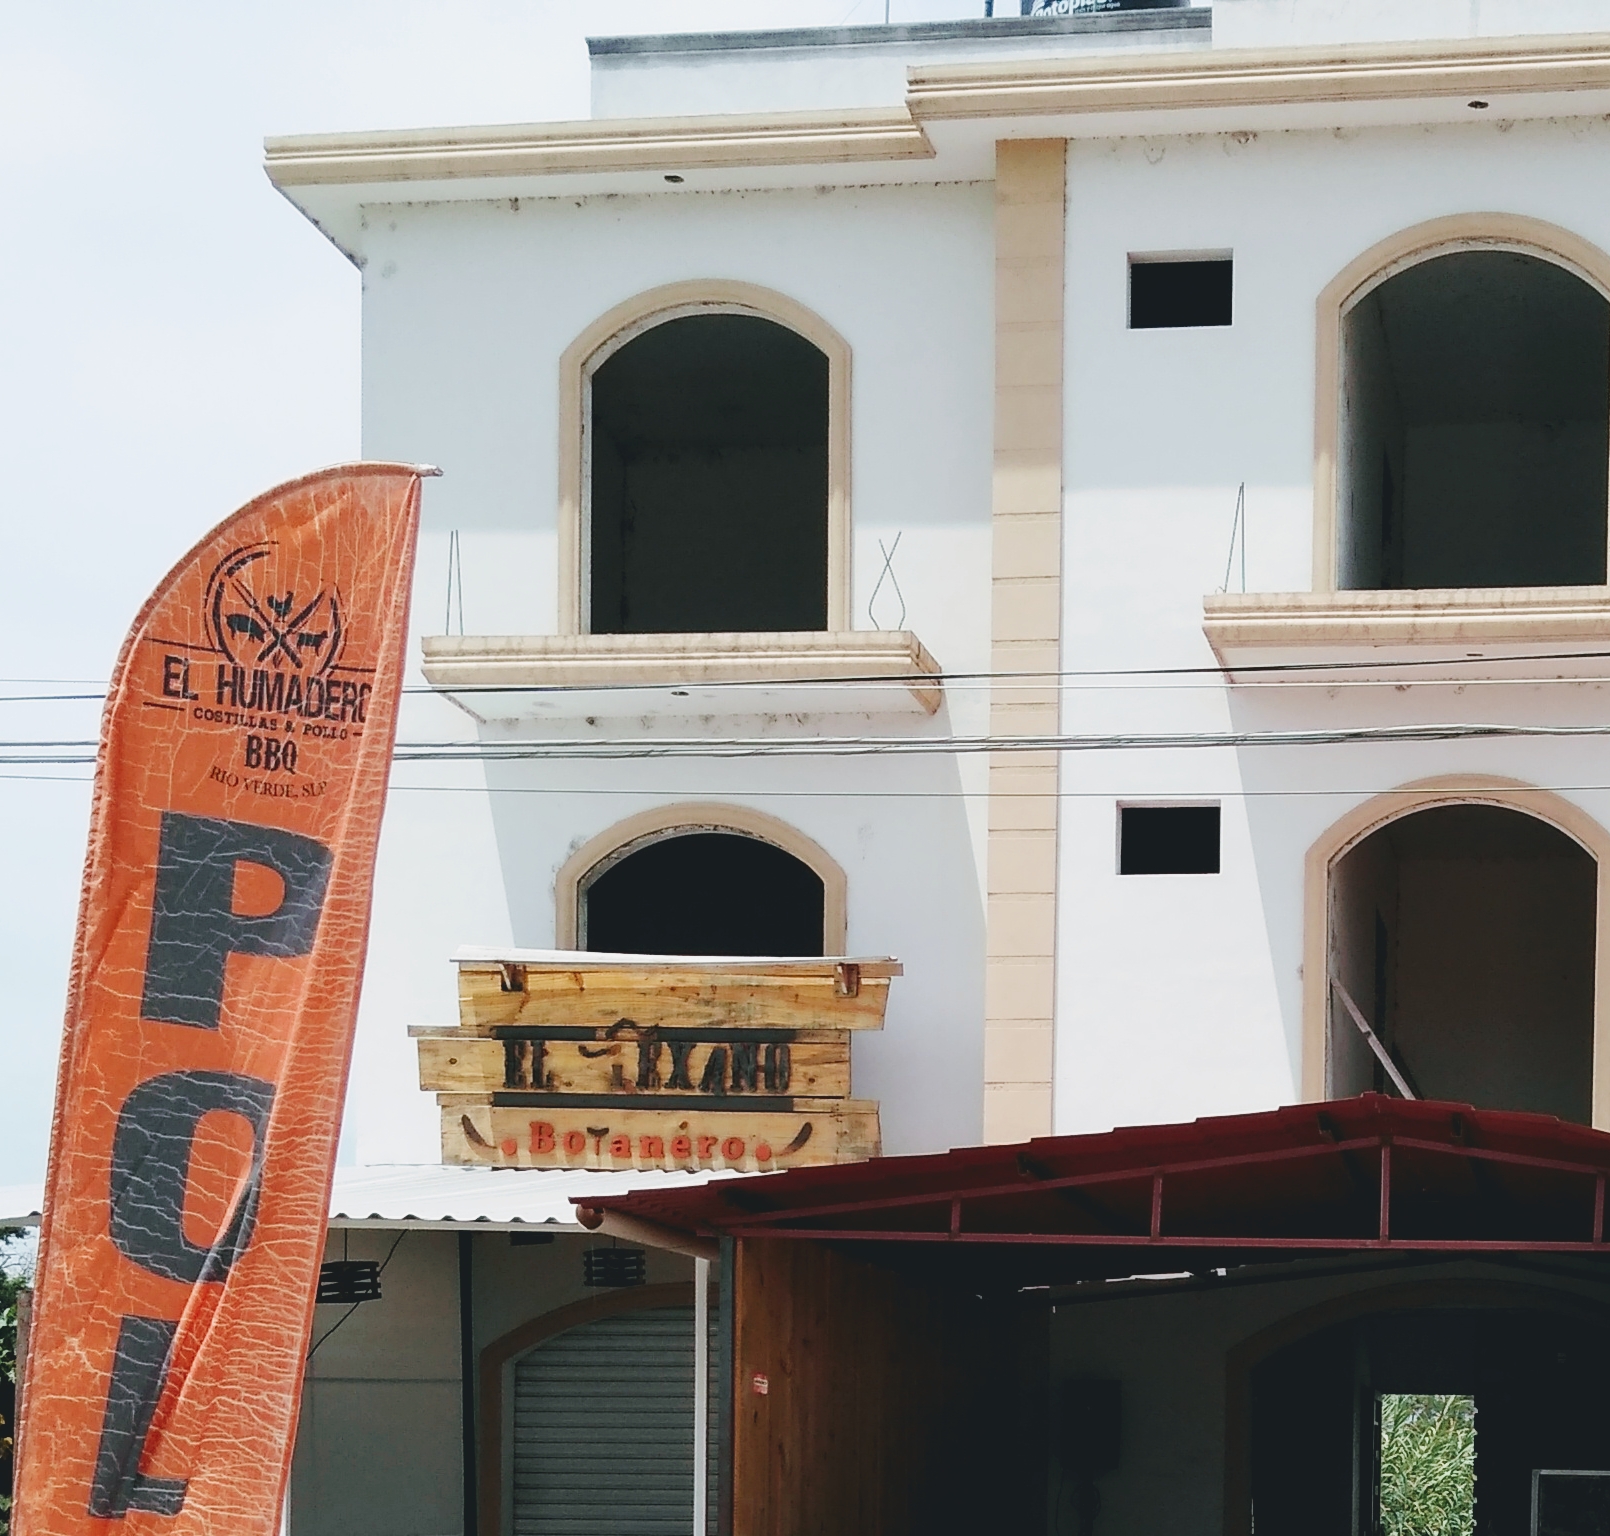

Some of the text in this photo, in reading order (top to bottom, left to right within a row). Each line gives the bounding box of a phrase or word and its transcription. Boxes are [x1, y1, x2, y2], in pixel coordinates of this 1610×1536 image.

[163, 655, 198, 700] EL
[194, 707, 277, 731] COSTILLAS
[302, 724, 347, 740] POLLO
[244, 734, 298, 774] BBQ
[209, 766, 238, 787] RIO
[502, 1039, 556, 1091] EL
